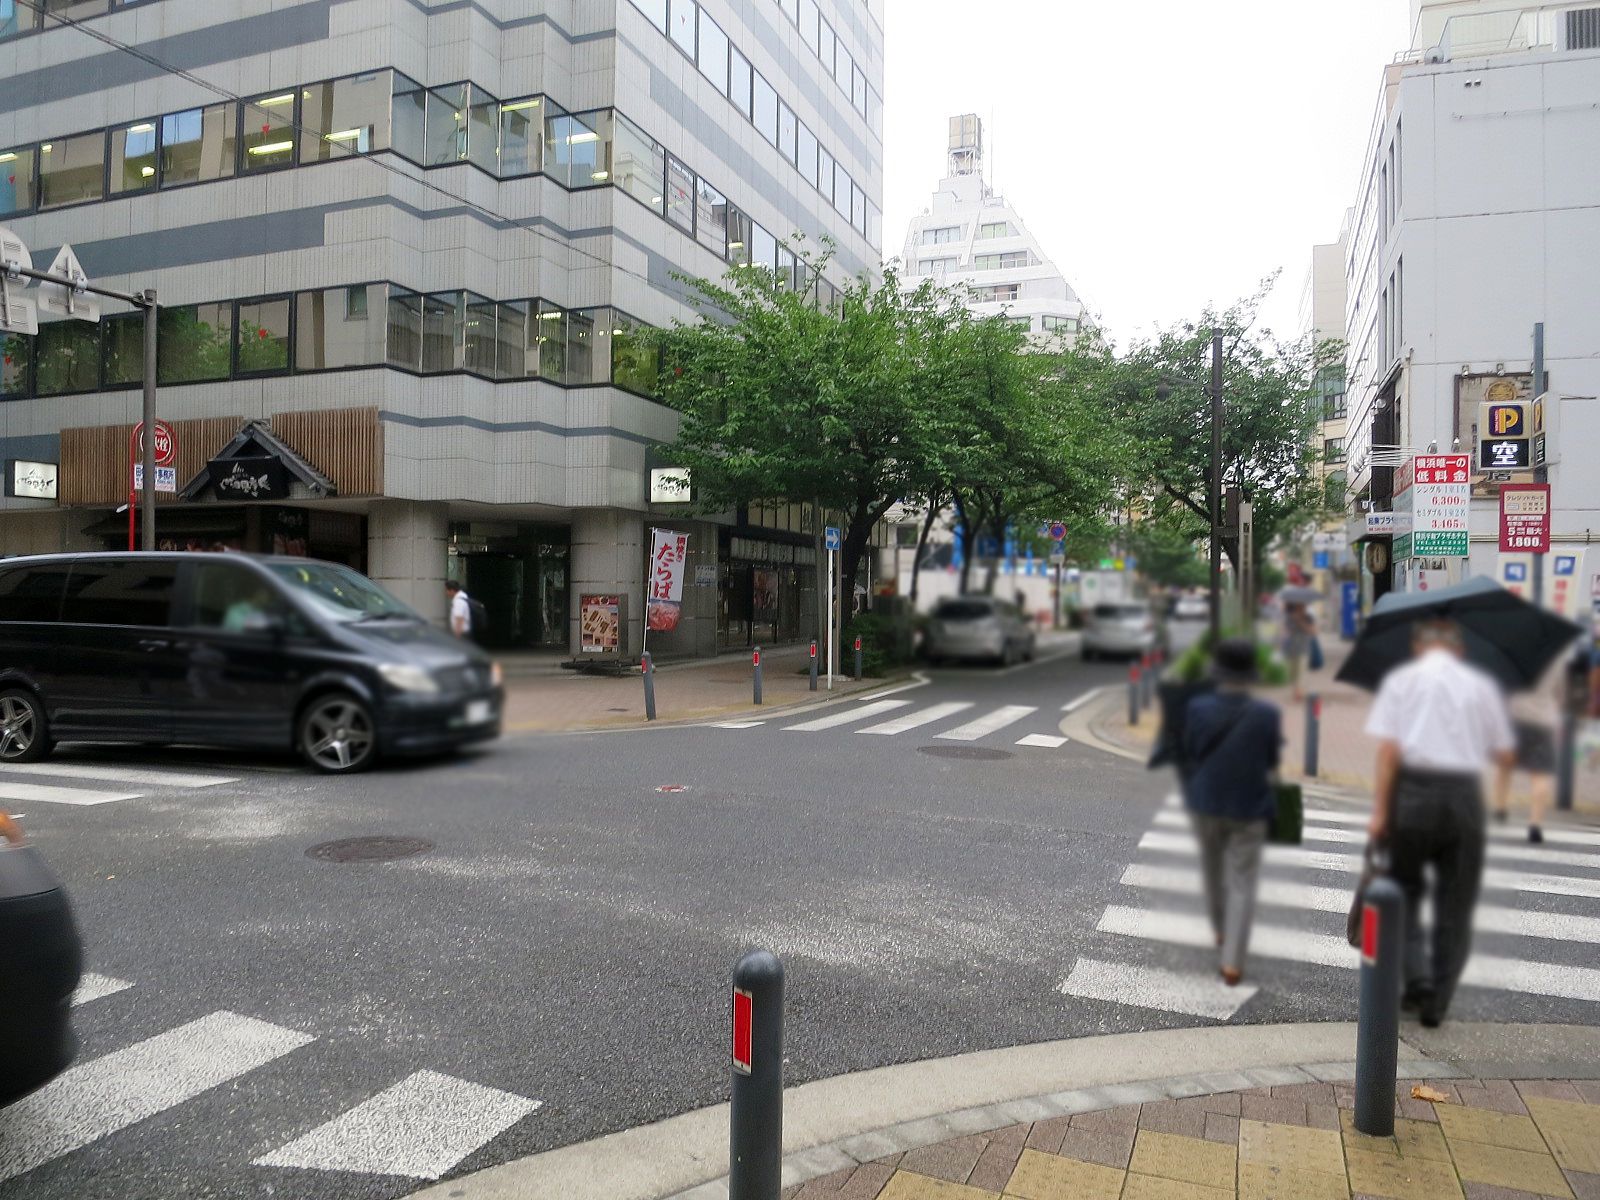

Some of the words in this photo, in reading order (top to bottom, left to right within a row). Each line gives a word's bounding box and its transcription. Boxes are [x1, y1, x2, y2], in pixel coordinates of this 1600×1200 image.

[1498, 408, 1518, 433] P
[1416, 457, 1466, 469] 横浜唯一の
[1492, 441, 1518, 465] 空
[1416, 470, 1466, 482] 低料金
[653, 542, 675, 600] たらば
